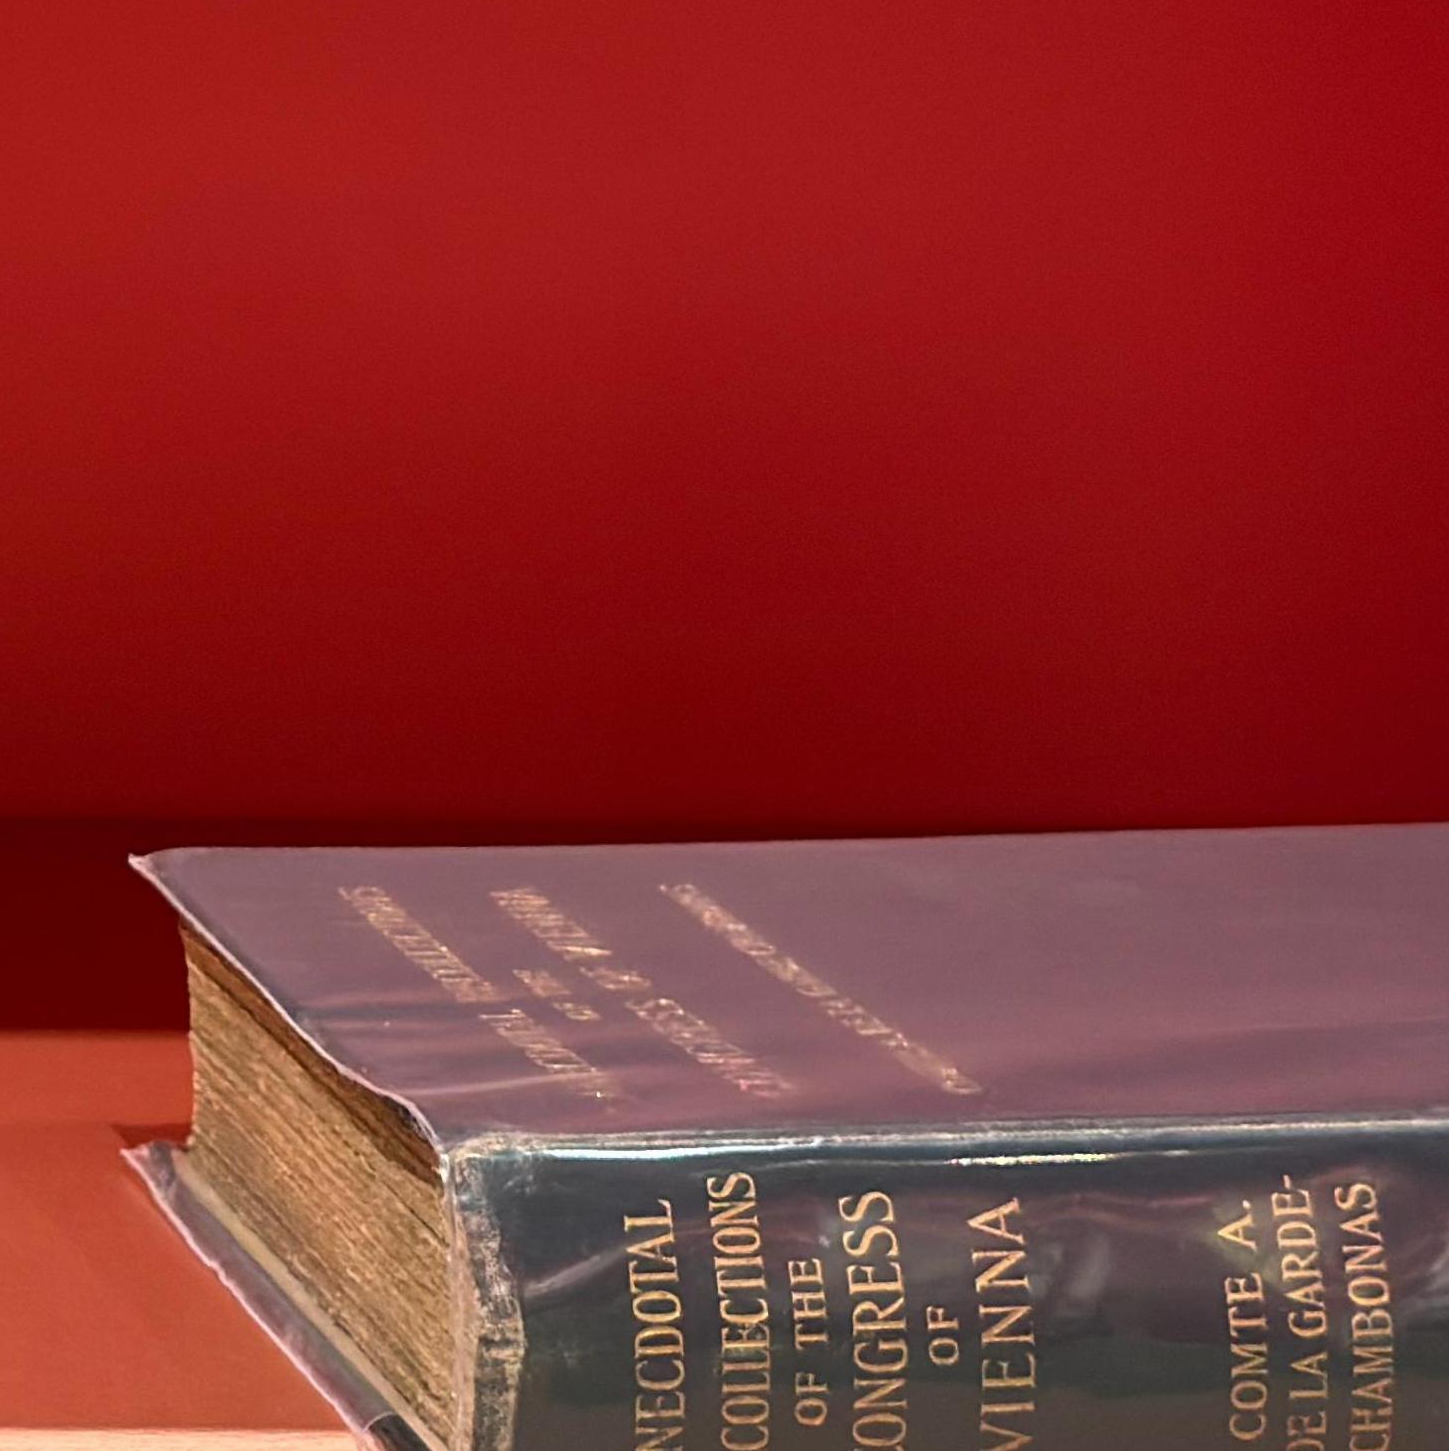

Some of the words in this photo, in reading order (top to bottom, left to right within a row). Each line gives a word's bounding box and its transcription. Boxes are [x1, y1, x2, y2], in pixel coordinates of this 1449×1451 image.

[788, 1258, 830, 1351] THE
[1217, 1199, 1258, 1253] A.
[1270, 1174, 1327, 1339] GARDE-
[624, 1200, 686, 1451] NECDOTAL
[794, 1370, 829, 1427] OF
[838, 1189, 908, 1451] ONGRESS
[928, 1305, 960, 1367] OF
[968, 1197, 1037, 1451] VIENNA
[1224, 1272, 1268, 1441] COMTE
[1288, 1351, 1328, 1400] LA
[1333, 1182, 1394, 1451] CHAMBONAS
